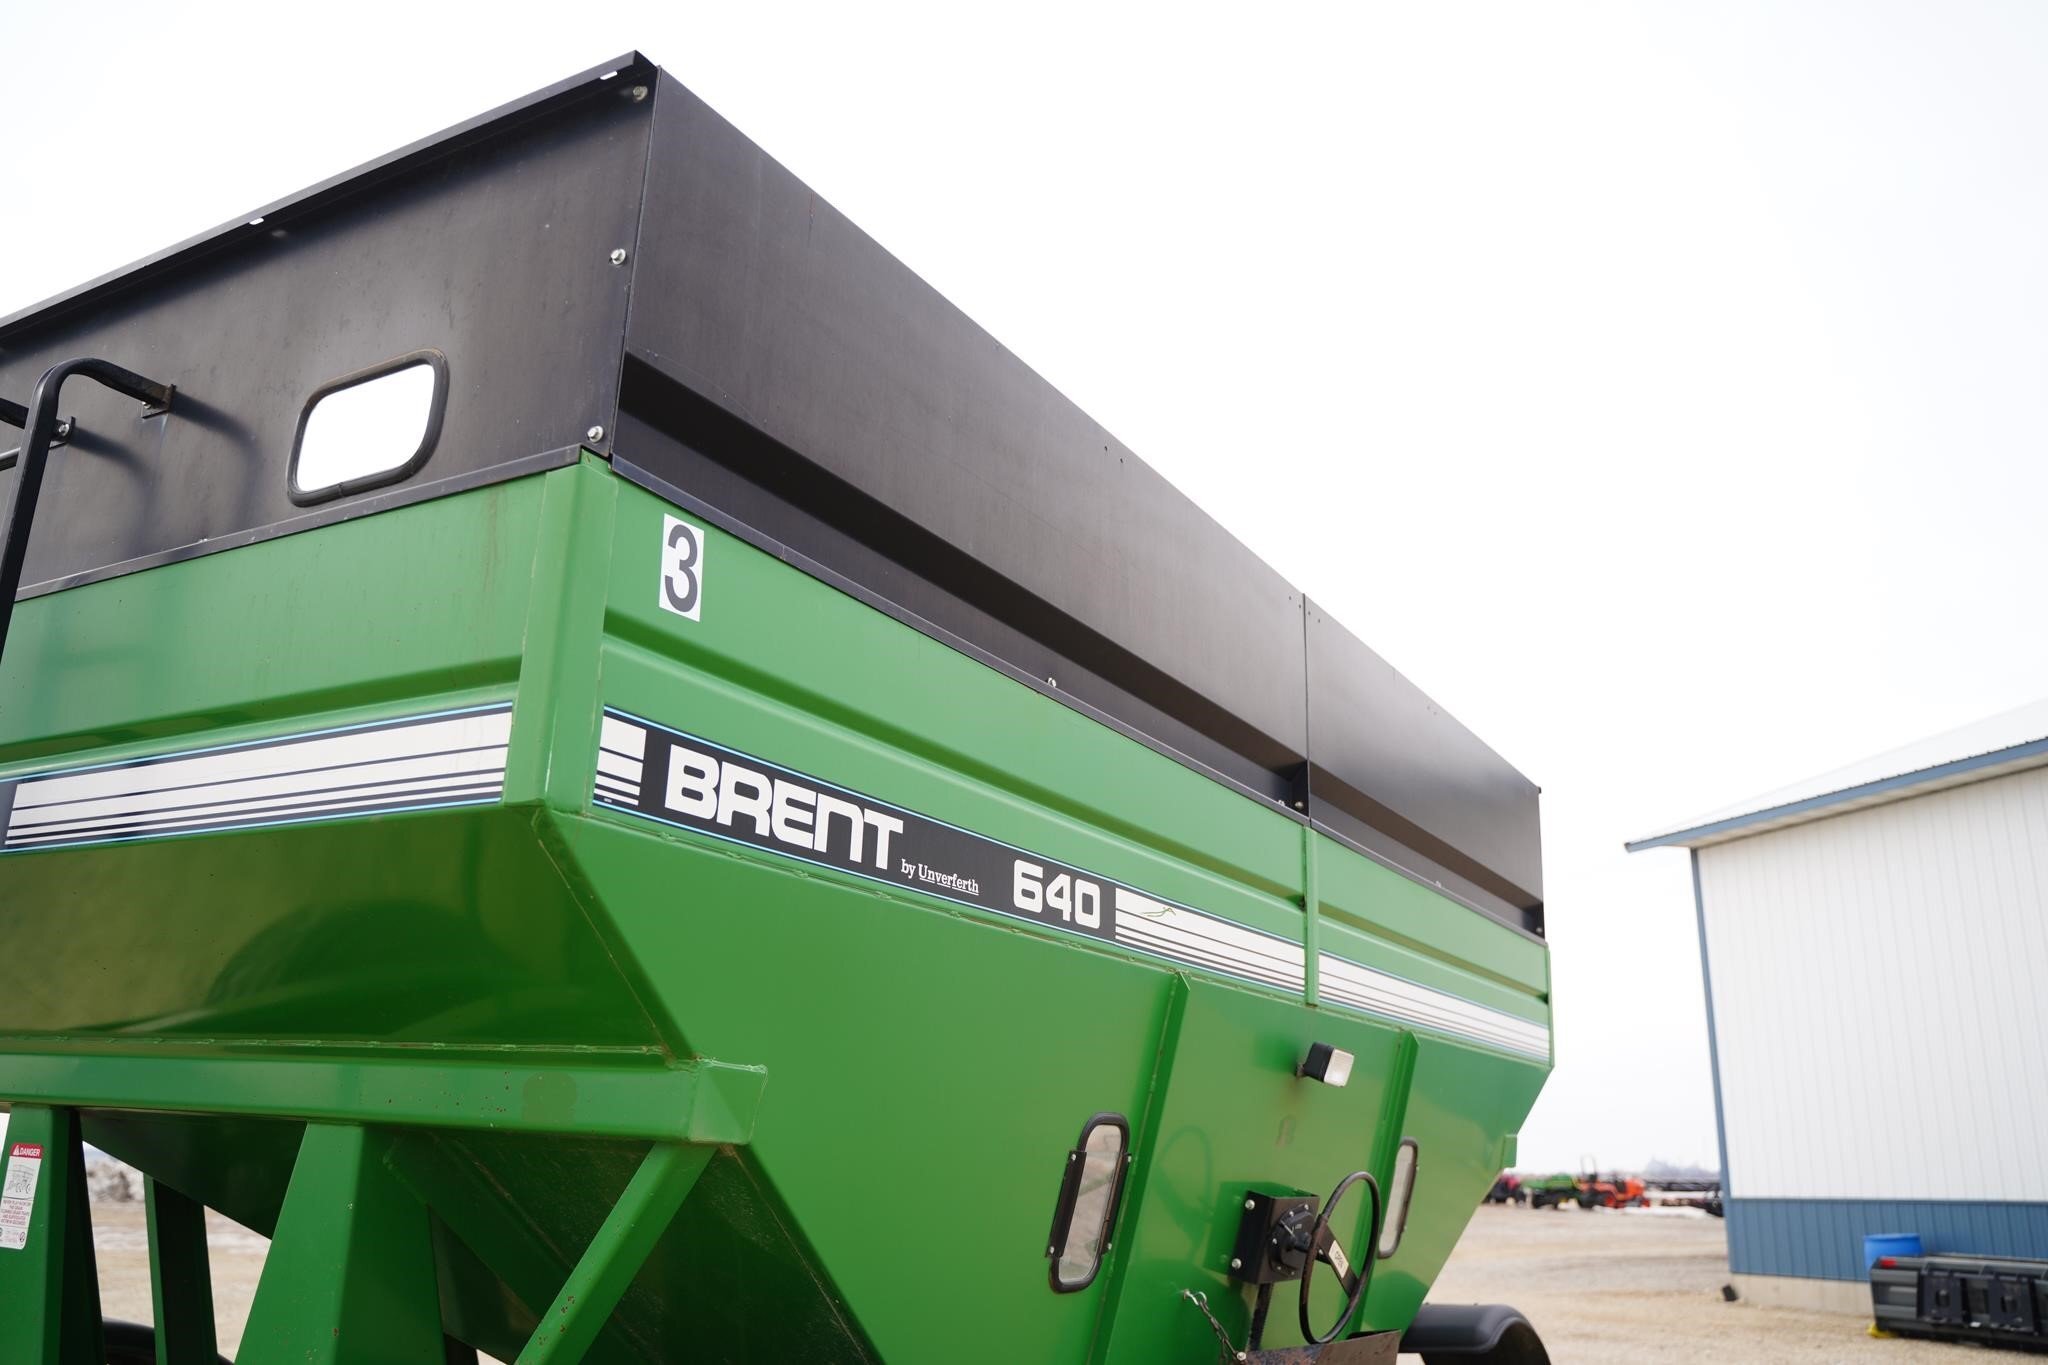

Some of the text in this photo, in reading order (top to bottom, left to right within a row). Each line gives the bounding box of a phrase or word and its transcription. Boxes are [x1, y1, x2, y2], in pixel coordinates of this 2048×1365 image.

[665, 524, 698, 613] 3
[665, 743, 904, 870] BRENT
[901, 858, 979, 895] by Unverferth
[1013, 859, 1101, 929] 640
[19, 1147, 41, 1157] DANGER
